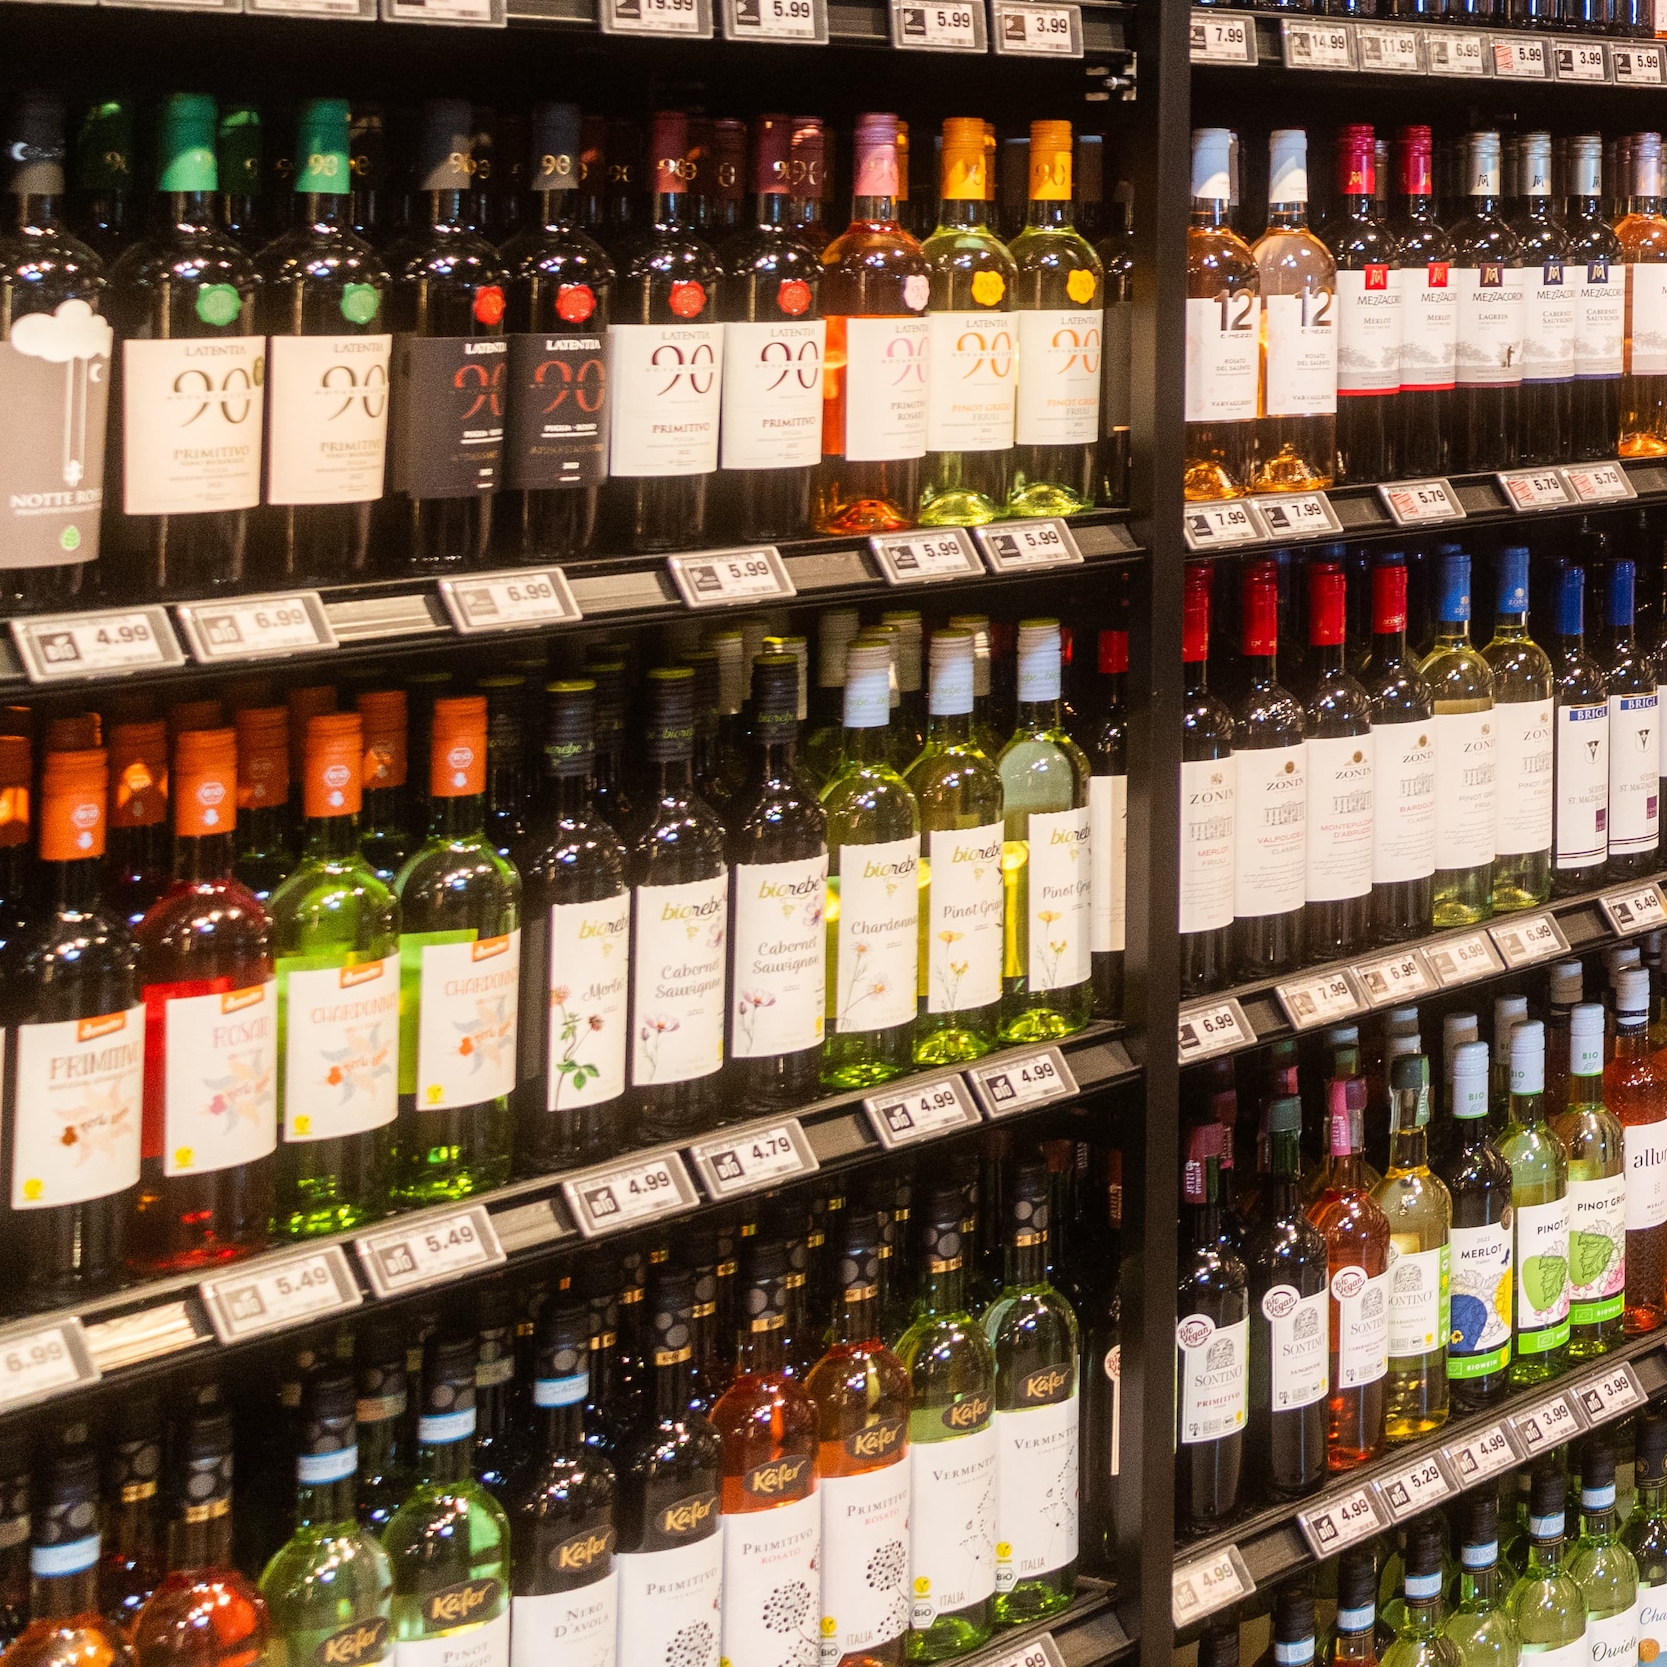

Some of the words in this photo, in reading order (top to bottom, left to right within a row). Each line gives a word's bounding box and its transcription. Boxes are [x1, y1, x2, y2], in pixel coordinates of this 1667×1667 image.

[773, 0, 810, 18] 5.99
[1036, 16, 1067, 34] 3.99
[1215, 288, 1254, 331] 12
[1420, 490, 1446, 504] 5.79
[1293, 503, 1322, 518] 7.99
[1024, 531, 1059, 548] 5.99
[1021, 1062, 1055, 1083] 4.99
[752, 1136, 792, 1160] 4.79
[1577, 1200, 1608, 1211] PINOT
[1460, 1243, 1503, 1260] MERLOT
[1466, 1360, 1498, 1372] BIOWEIN
[1025, 1370, 1070, 1398] Käfer
[1545, 1405, 1569, 1426] 3.99
[751, 1460, 806, 1496] Käfer
[1411, 1466, 1440, 1487] 5.29
